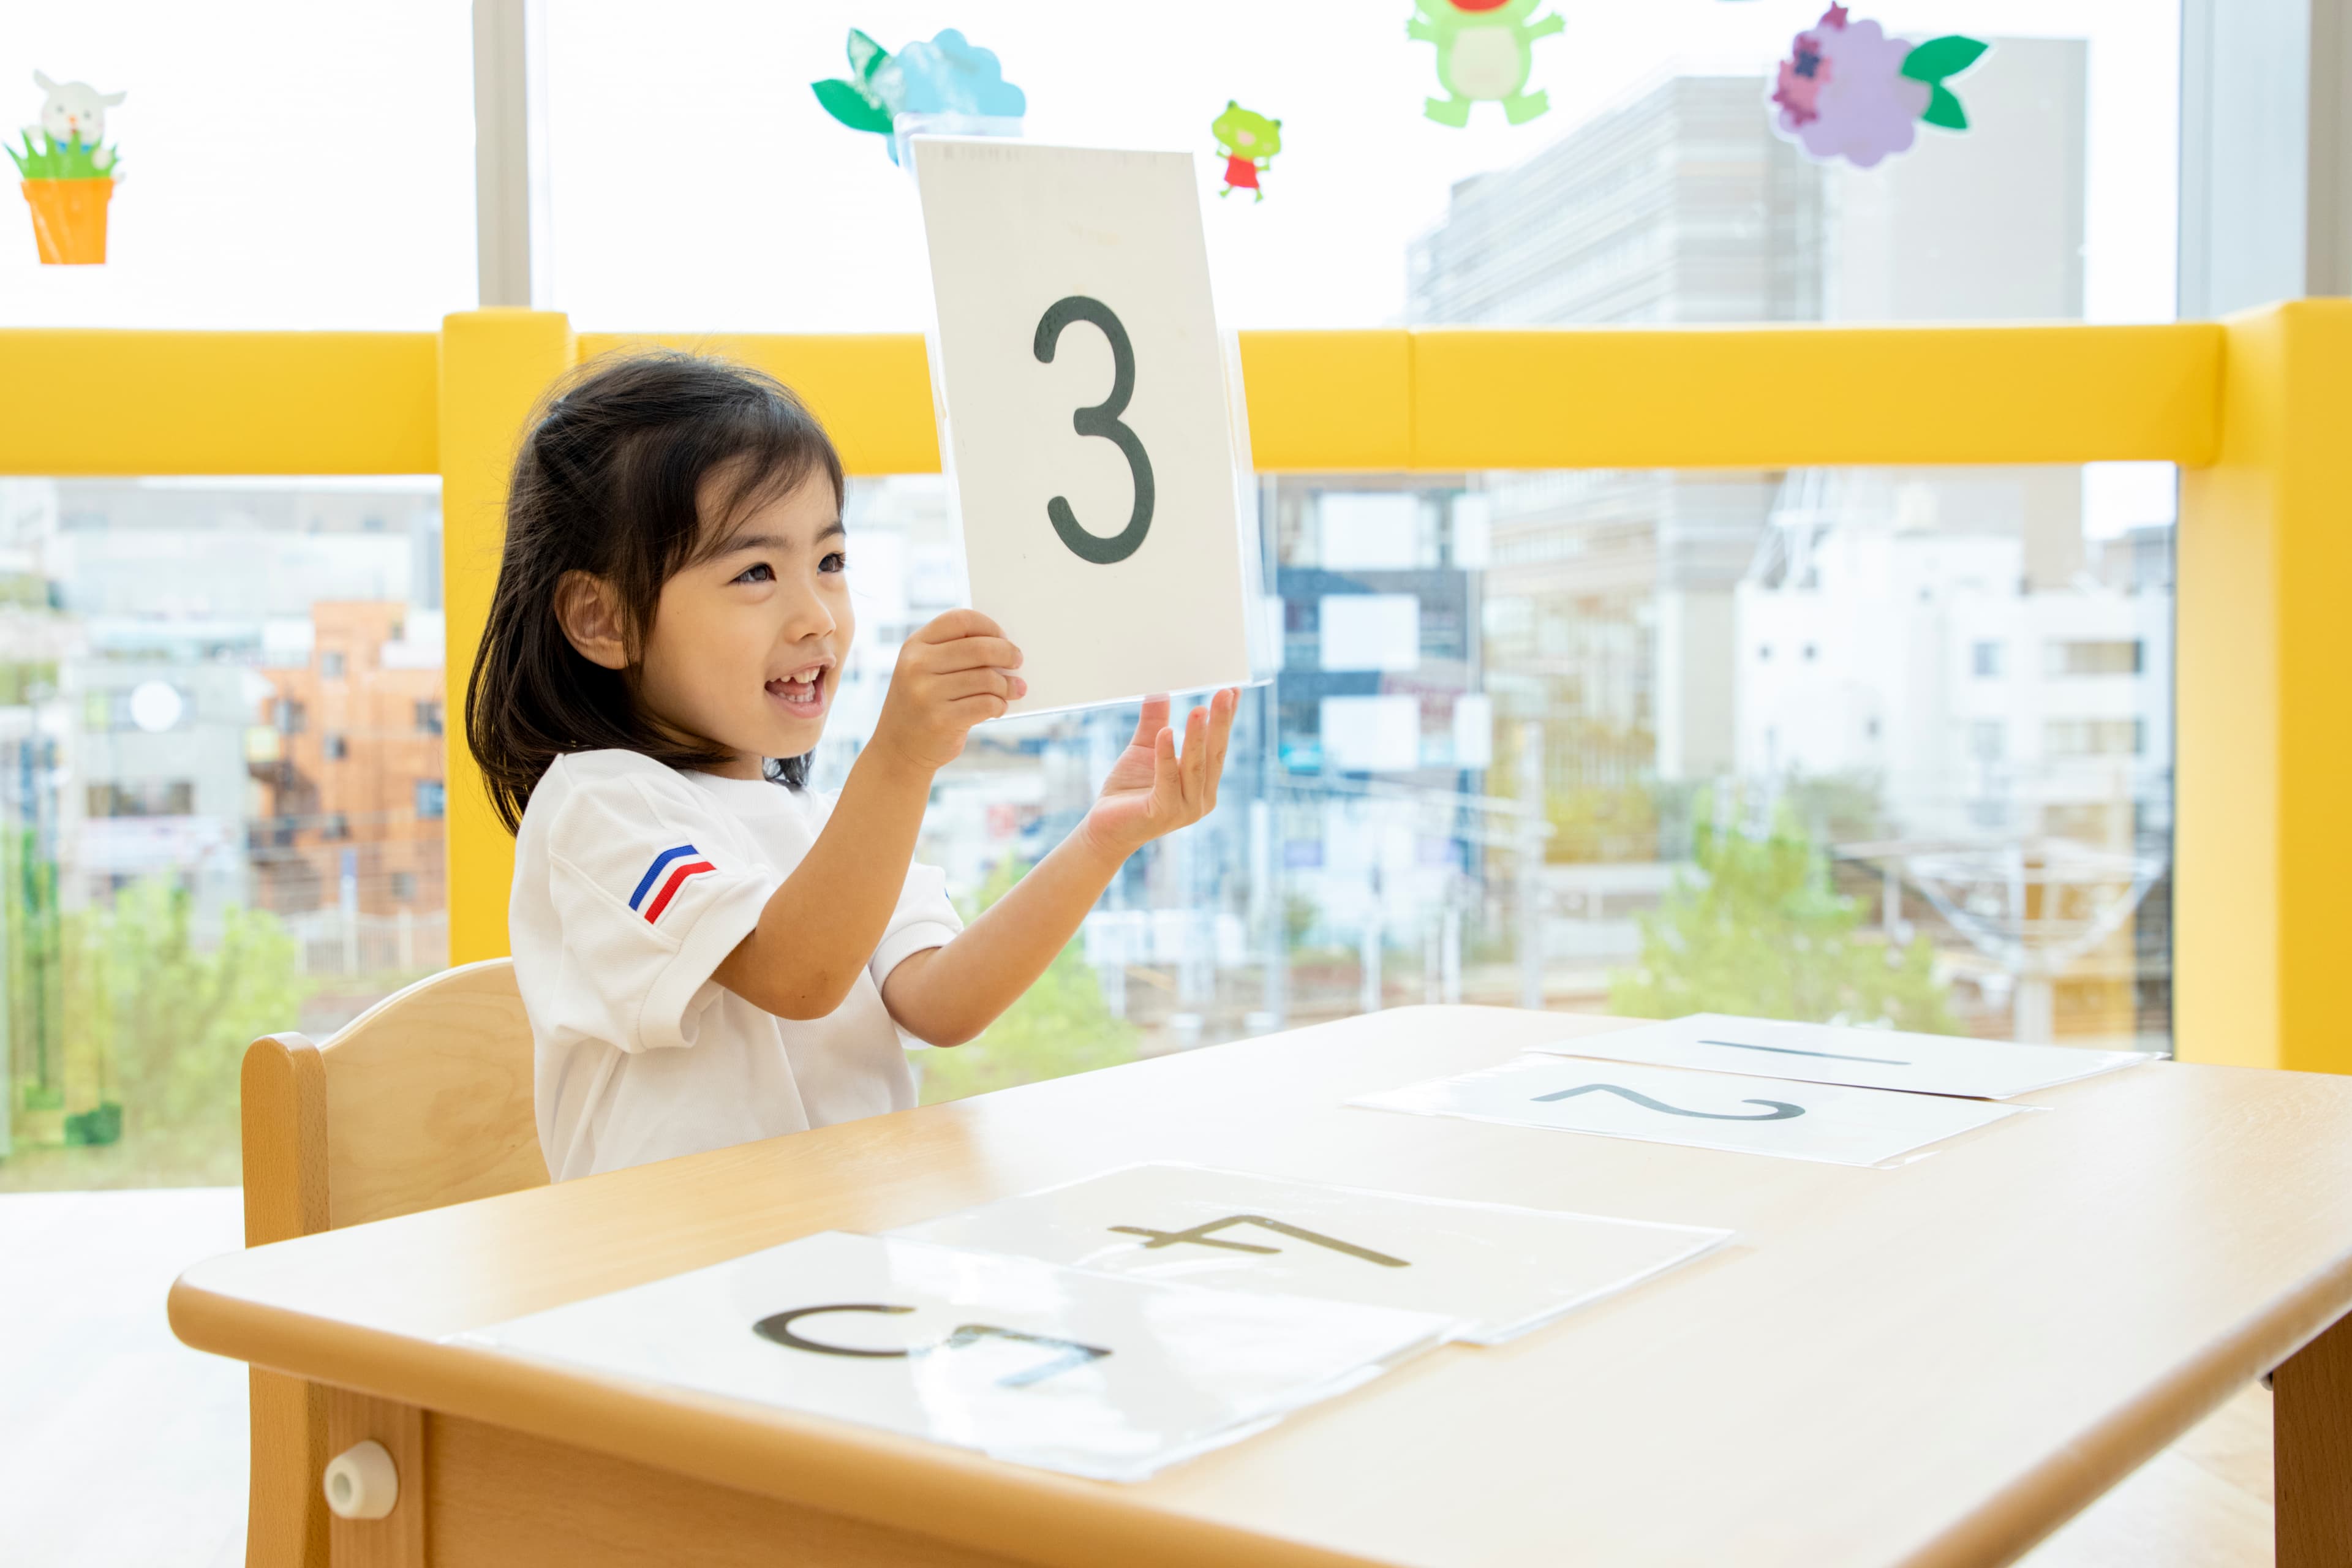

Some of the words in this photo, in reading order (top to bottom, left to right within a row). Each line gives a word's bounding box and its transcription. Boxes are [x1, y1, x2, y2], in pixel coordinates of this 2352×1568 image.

[1034, 295, 1155, 565] 3
[1697, 1040, 1912, 1065] 1
[1530, 1084, 1806, 1121] 2
[1108, 1214, 1412, 1267] 4
[752, 1303, 1113, 1387] 5
